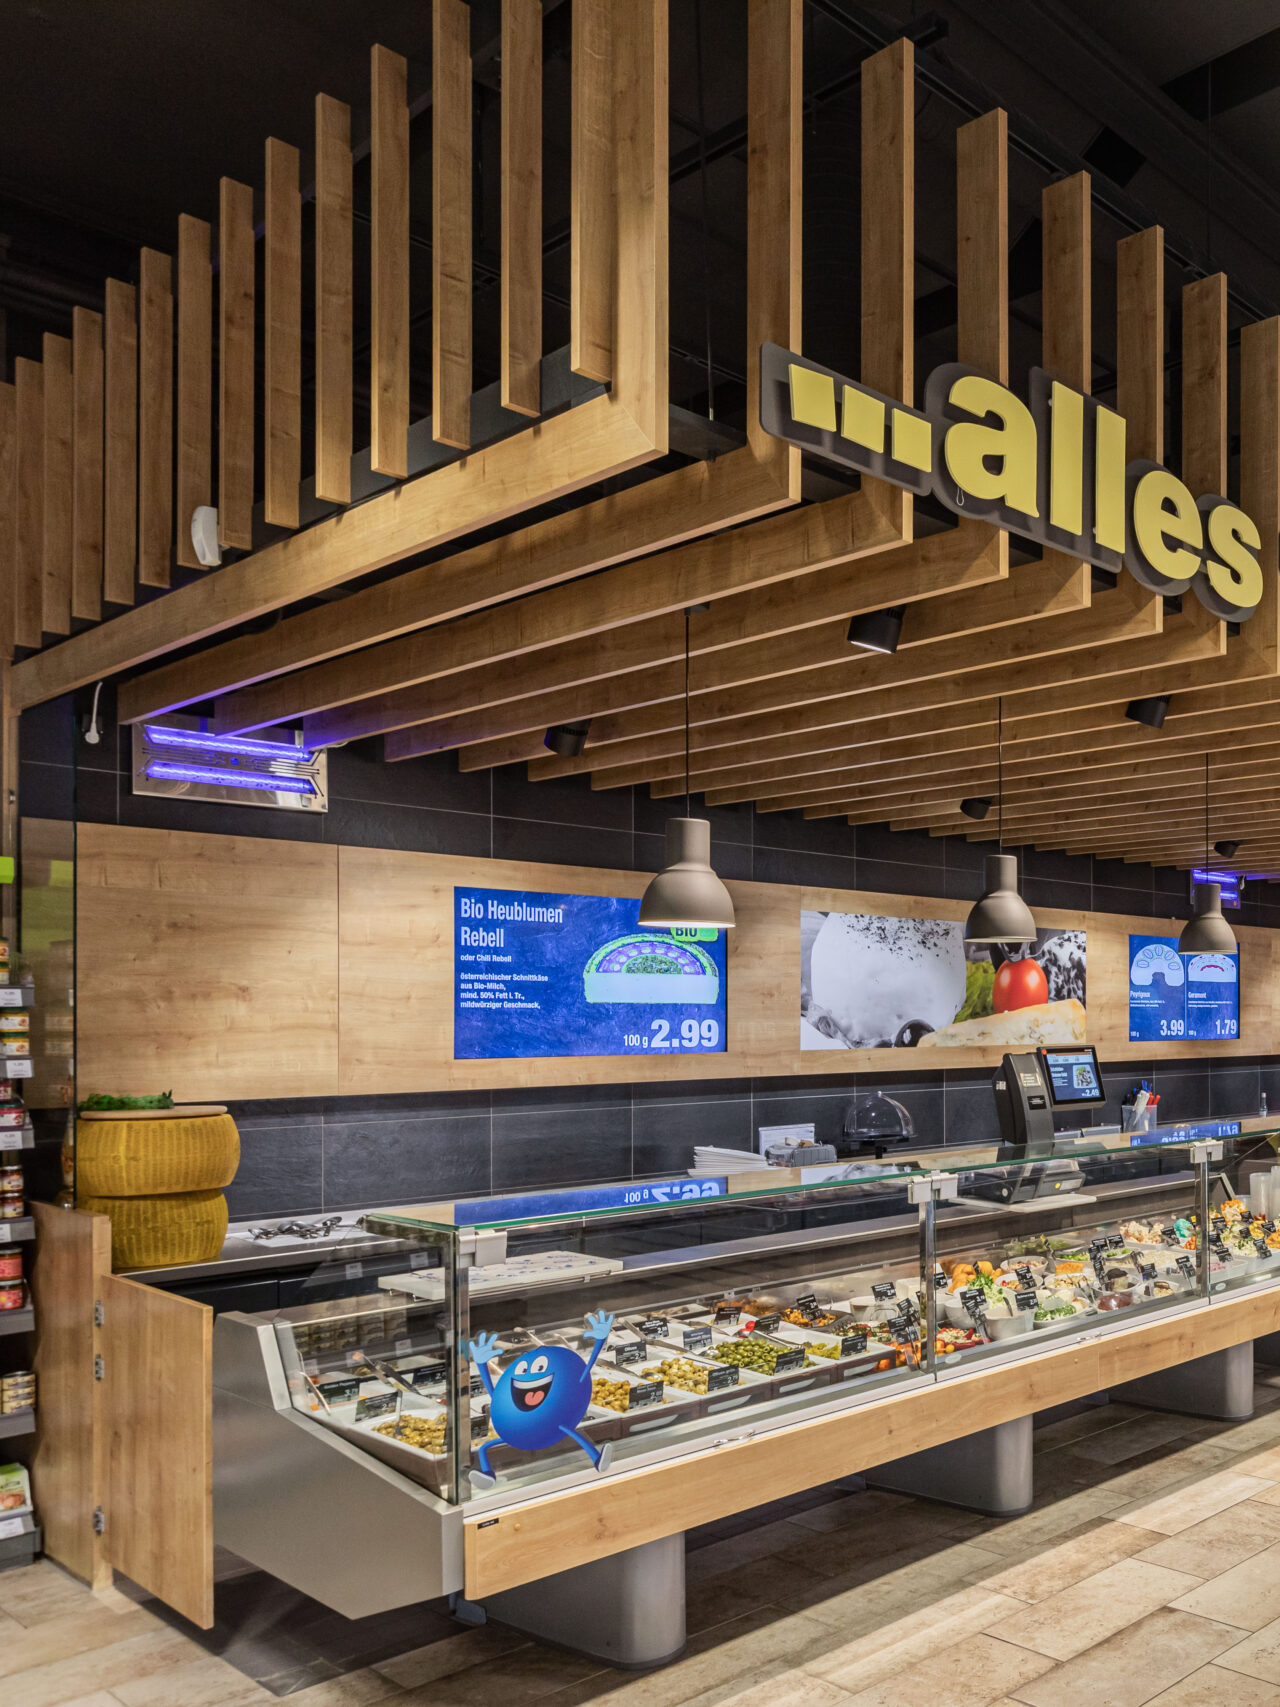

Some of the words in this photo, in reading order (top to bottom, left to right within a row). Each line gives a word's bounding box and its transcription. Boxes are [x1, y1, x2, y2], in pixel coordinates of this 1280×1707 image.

[460, 898, 484, 919] Bio
[487, 900, 563, 923] Heublumen
[460, 926, 504, 948] Rebell
[675, 928, 698, 938] BIO
[460, 954, 475, 962] oder
[492, 955, 512, 963] Rebell
[460, 973, 511, 981] österreichischer
[512, 974, 548, 982] Schnittkäse
[473, 982, 506, 991] Bio-Milch,
[460, 1001, 502, 1010] mildwürziger
[503, 1002, 541, 1010] Geschmack,
[623, 1034, 642, 1047] 100
[642, 1036, 648, 1048] g
[650, 1019, 719, 1048] 2.99
[1160, 1020, 1185, 1036] 3.99
[1215, 1019, 1237, 1035] 1.79
